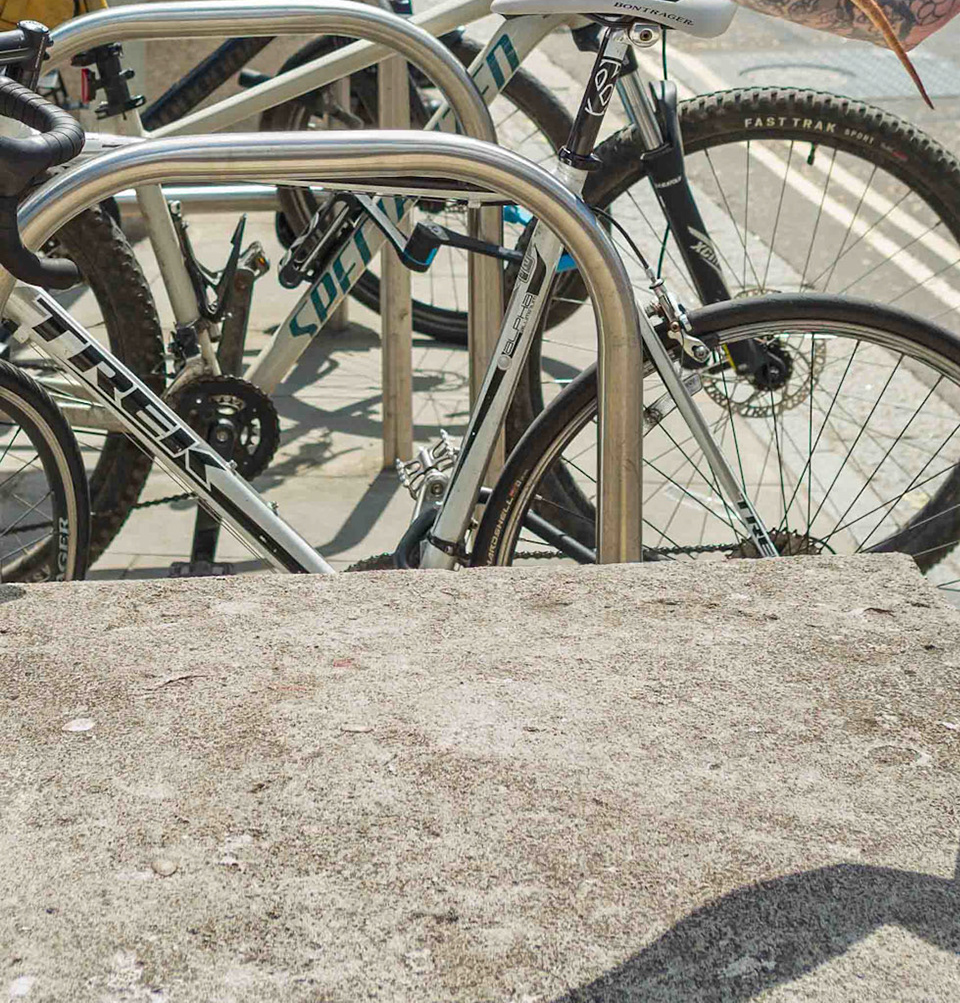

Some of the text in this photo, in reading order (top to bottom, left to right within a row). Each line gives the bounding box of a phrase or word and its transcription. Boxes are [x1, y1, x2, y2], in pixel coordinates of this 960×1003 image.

[614, 1, 694, 26] BONTRAGER
[744, 117, 787, 128] FAST
[793, 117, 837, 133] TRAK
[32, 297, 227, 491] TREK
[737, 493, 777, 557] TRE
